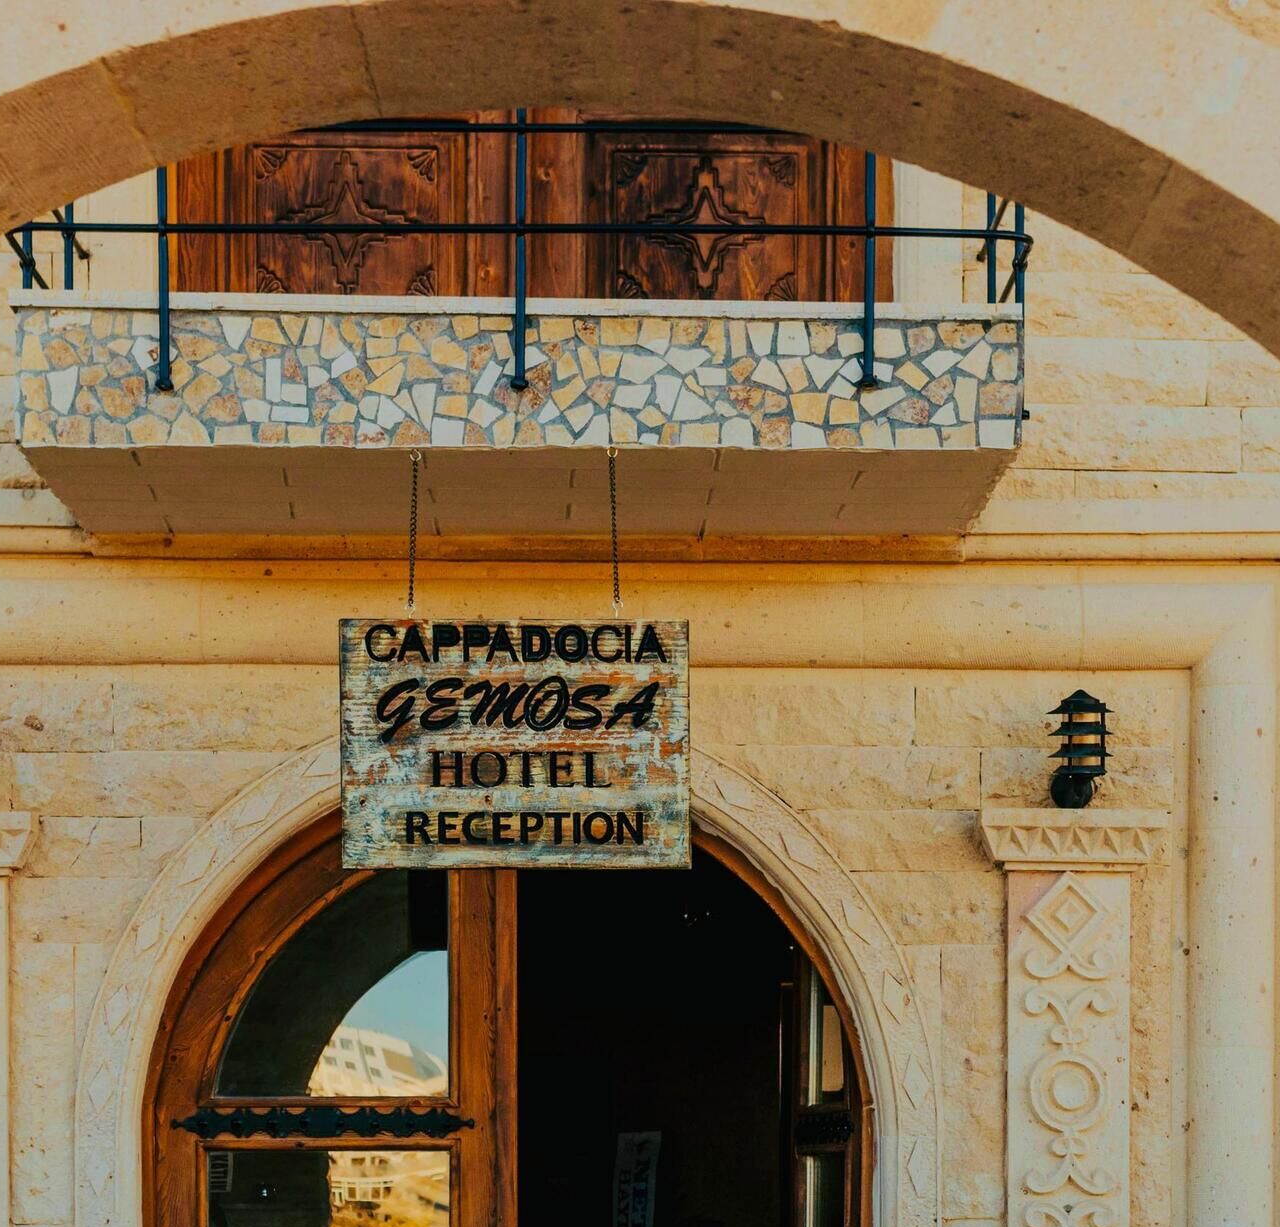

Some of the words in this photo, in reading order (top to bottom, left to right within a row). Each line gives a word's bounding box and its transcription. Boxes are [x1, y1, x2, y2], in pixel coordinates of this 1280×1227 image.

[364, 623, 668, 664] CAPPADOCIA
[375, 675, 661, 744] GEMOSA
[429, 750, 612, 789] HOTEL
[405, 811, 645, 846] RECEPTION
